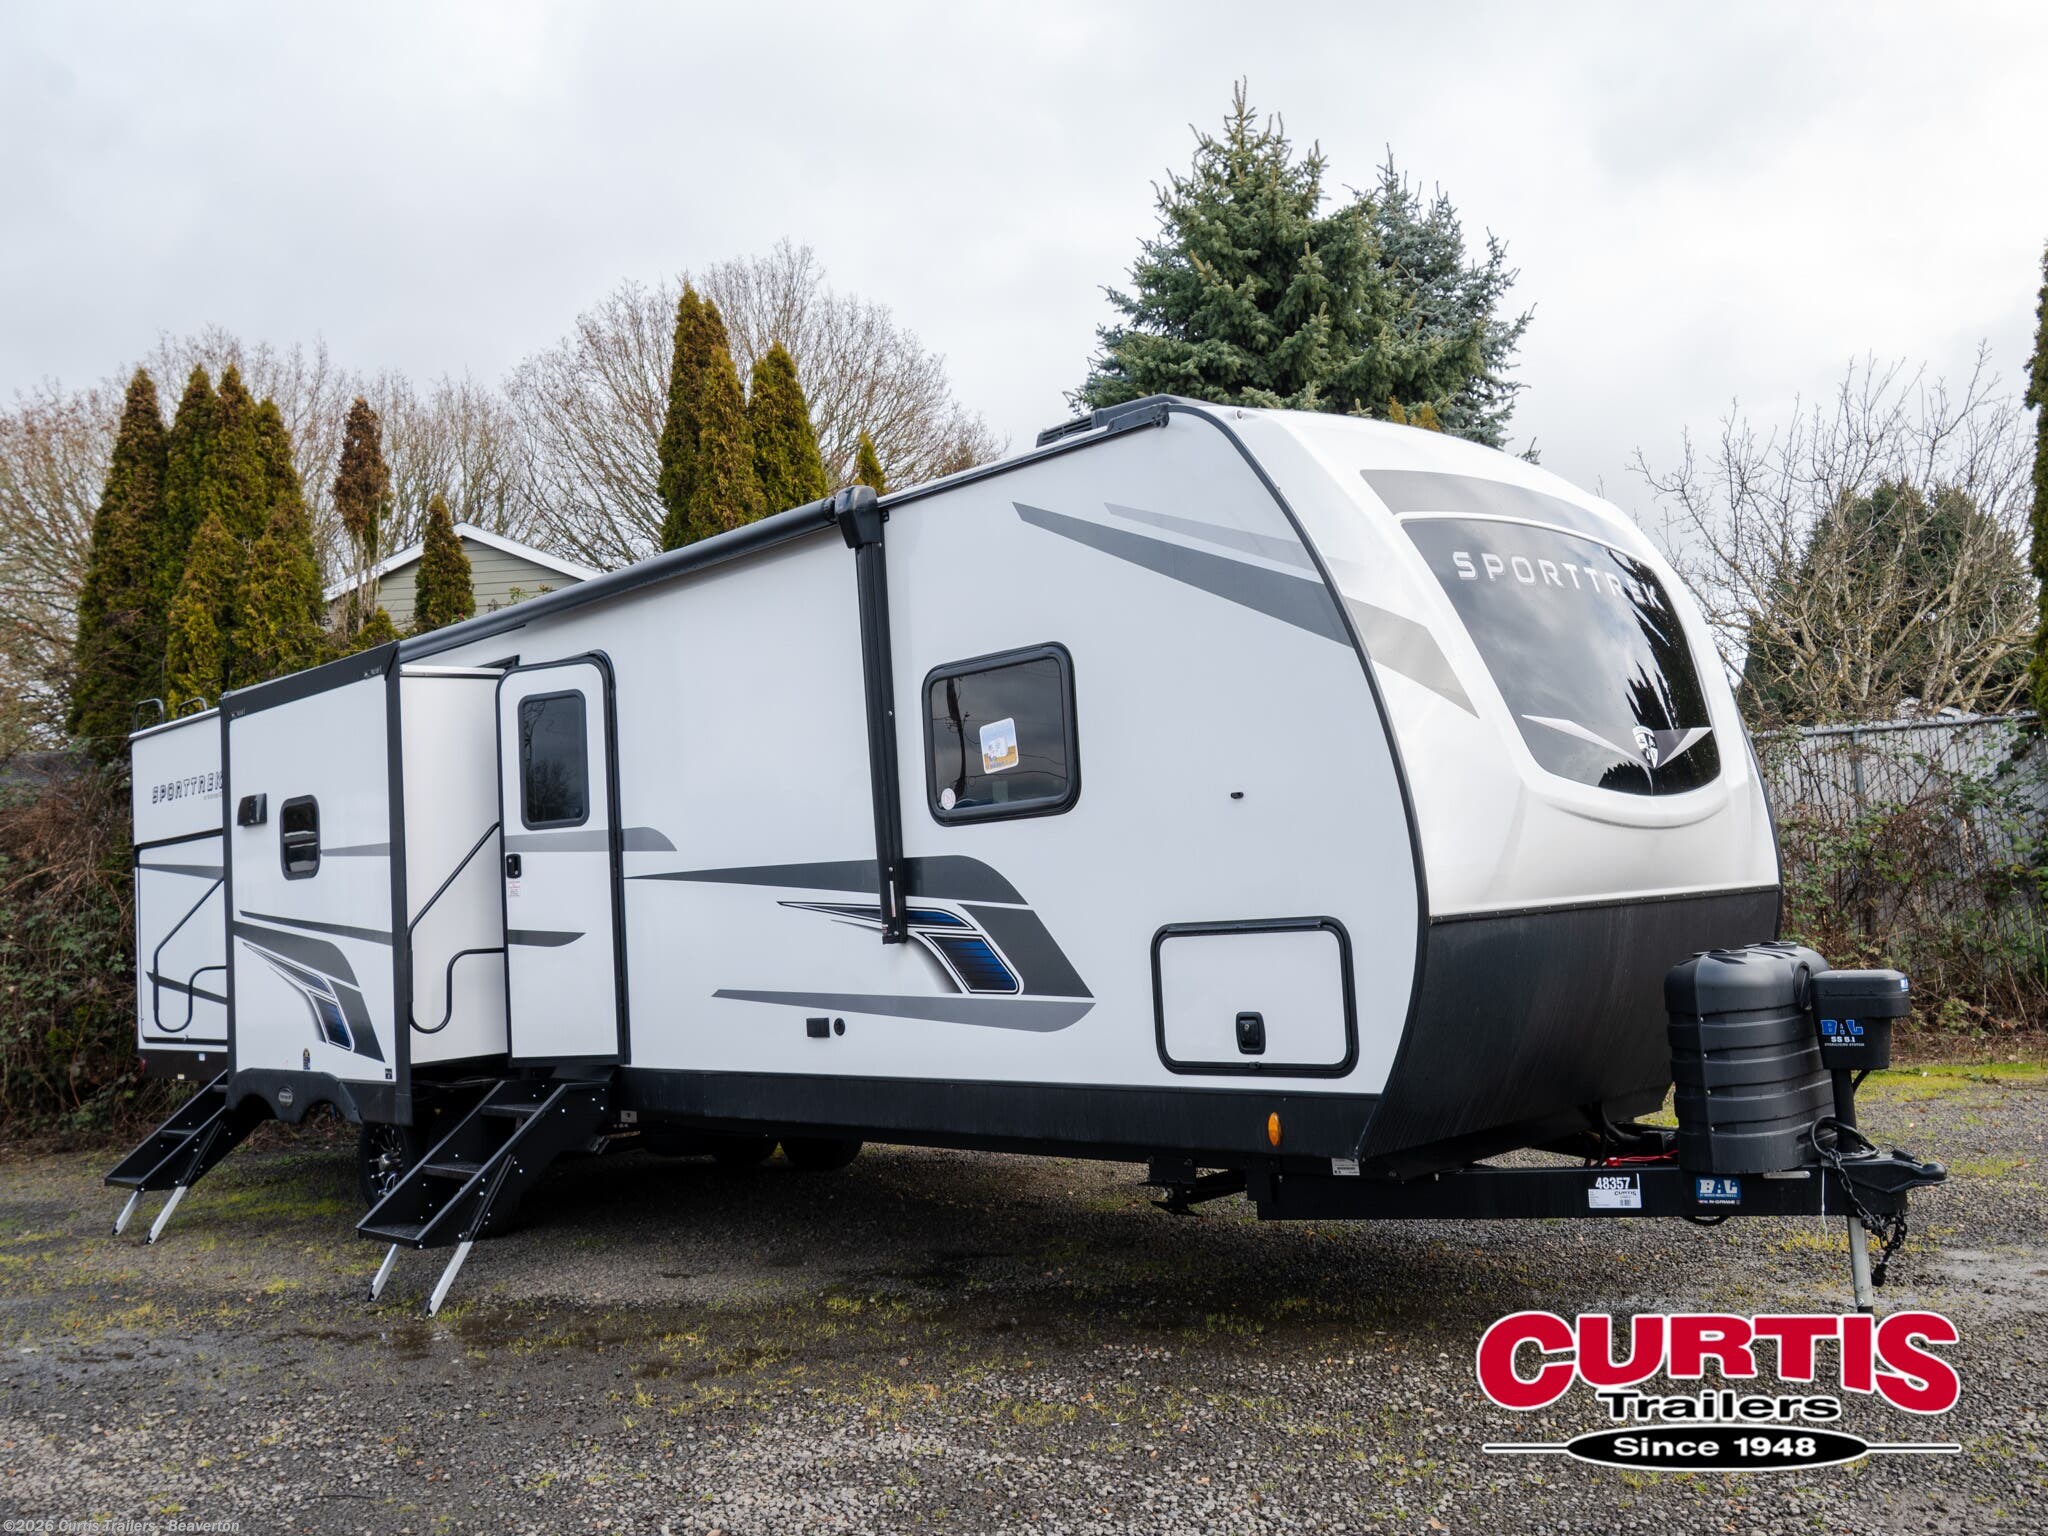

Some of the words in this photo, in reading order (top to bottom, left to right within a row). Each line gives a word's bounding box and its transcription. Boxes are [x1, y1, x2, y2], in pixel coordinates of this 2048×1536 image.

[1452, 550, 1665, 611] SPORTTREK
[1595, 1176, 1630, 1189] 48357
[1699, 1179, 1738, 1194] BAL
